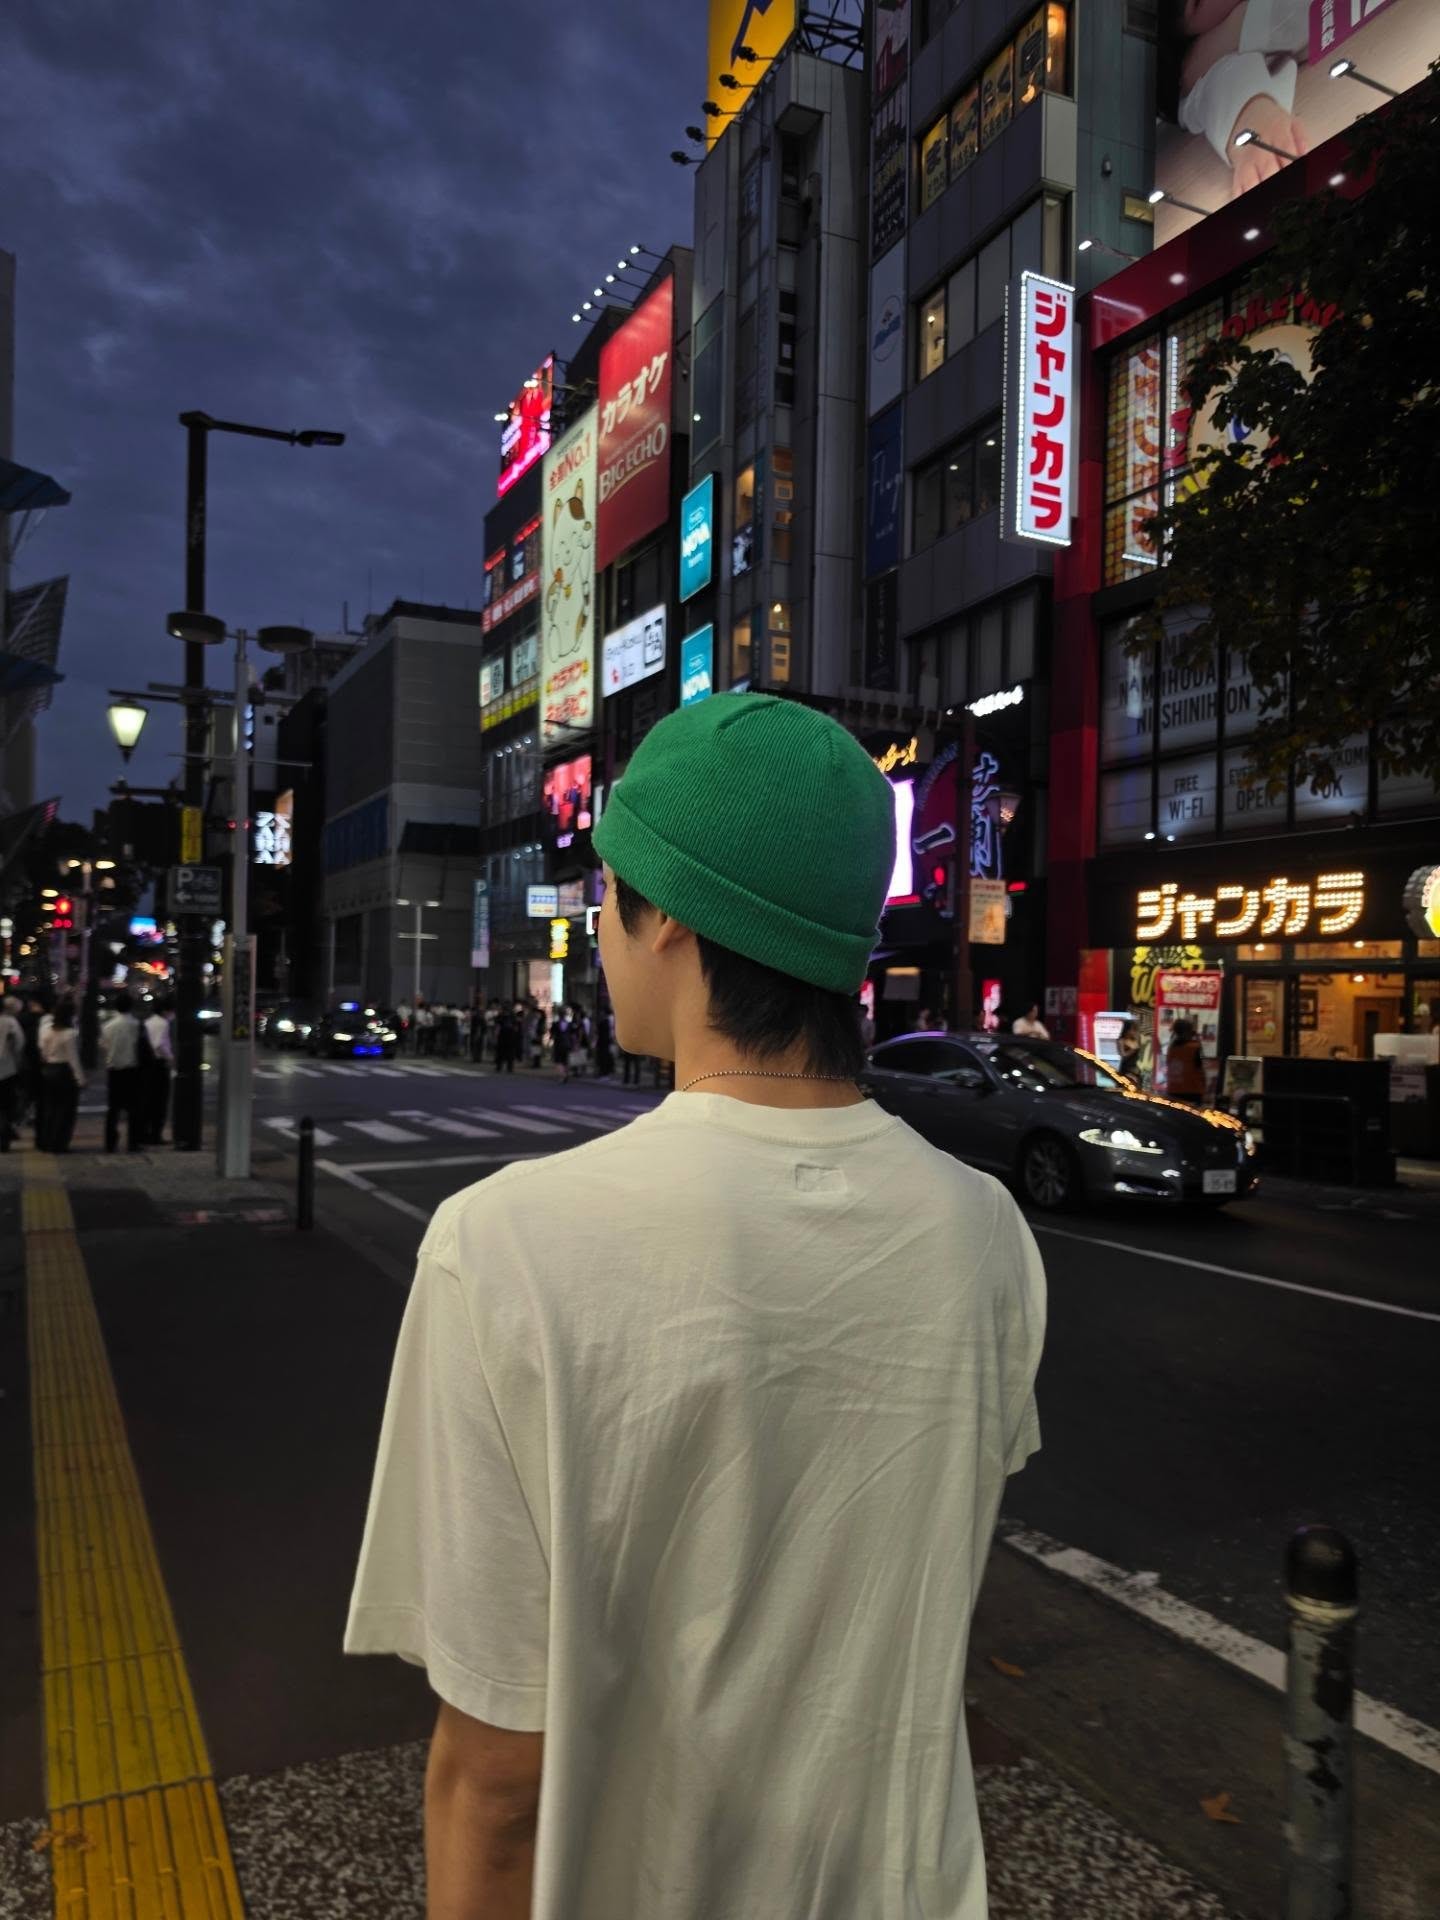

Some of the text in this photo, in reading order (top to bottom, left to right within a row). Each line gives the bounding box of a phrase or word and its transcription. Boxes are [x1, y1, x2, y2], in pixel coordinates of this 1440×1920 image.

[602, 352, 668, 438] カラオケ
[1030, 291, 1068, 529] ジャンカラ
[600, 459, 625, 500] BIG
[627, 422, 667, 471] ECHO
[1169, 797, 1204, 821] WI-FI
[1174, 775, 1199, 794] FREE
[177, 870, 194, 890] P
[1137, 871, 1365, 941] ジャンカラ
